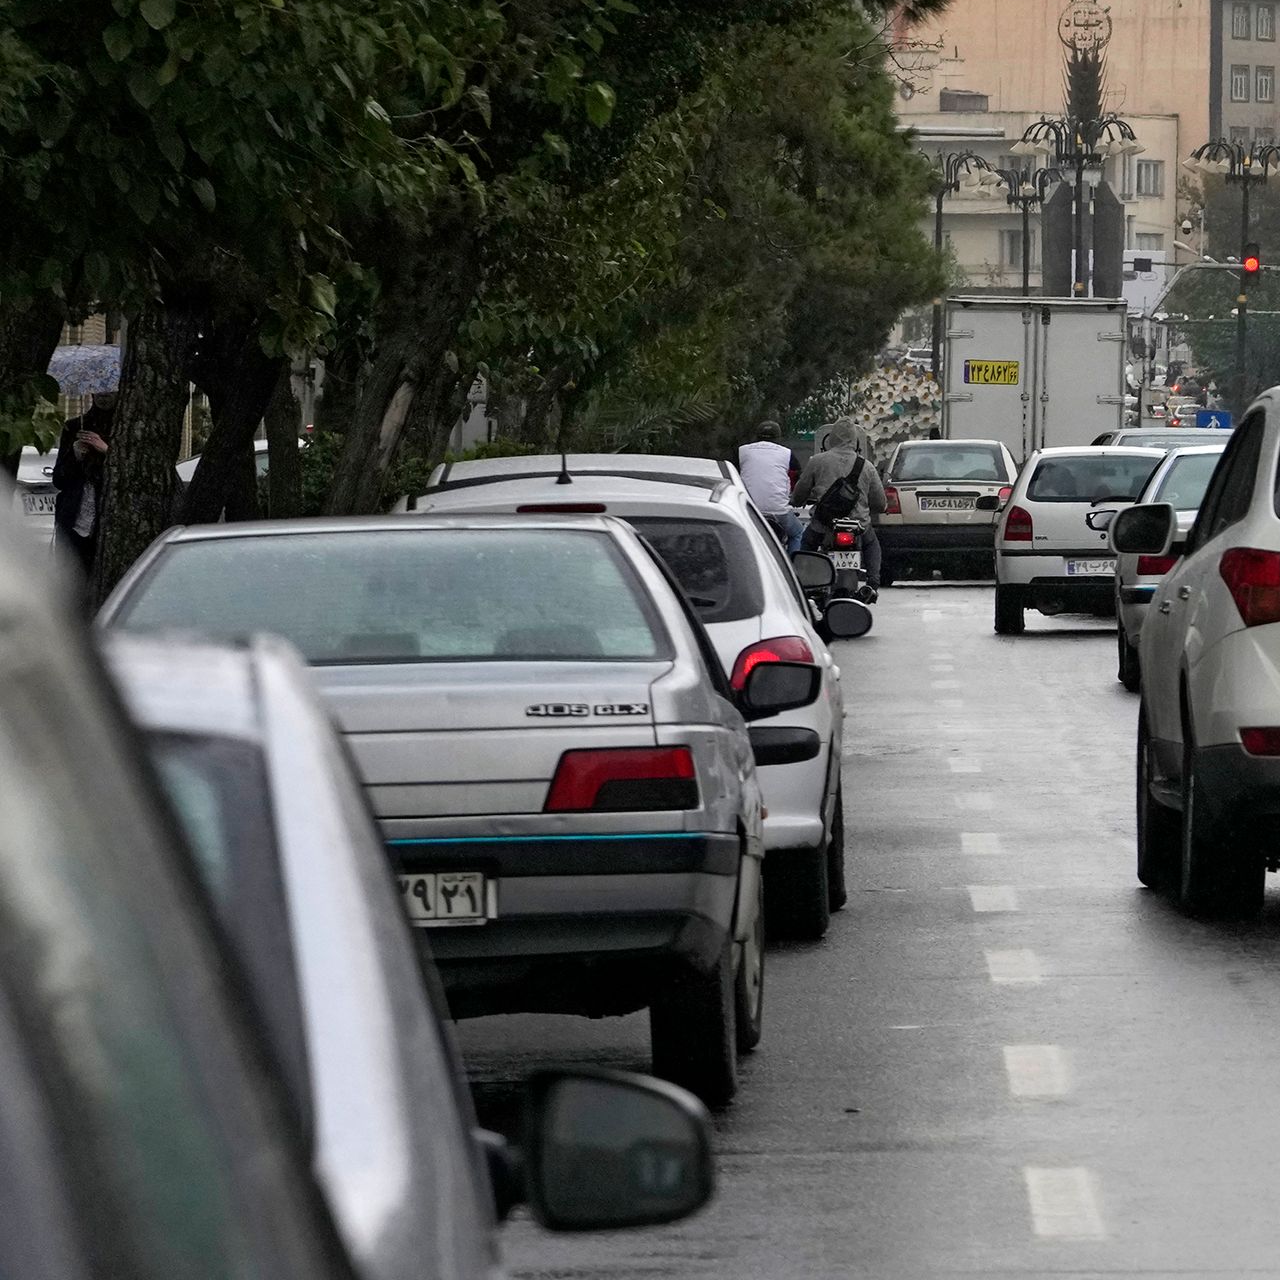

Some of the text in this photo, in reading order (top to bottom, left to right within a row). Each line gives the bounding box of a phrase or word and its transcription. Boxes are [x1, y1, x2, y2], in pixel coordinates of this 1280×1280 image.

[1064, 16, 1104, 31] جهاد
[525, 702, 648, 718] 405 GLX
